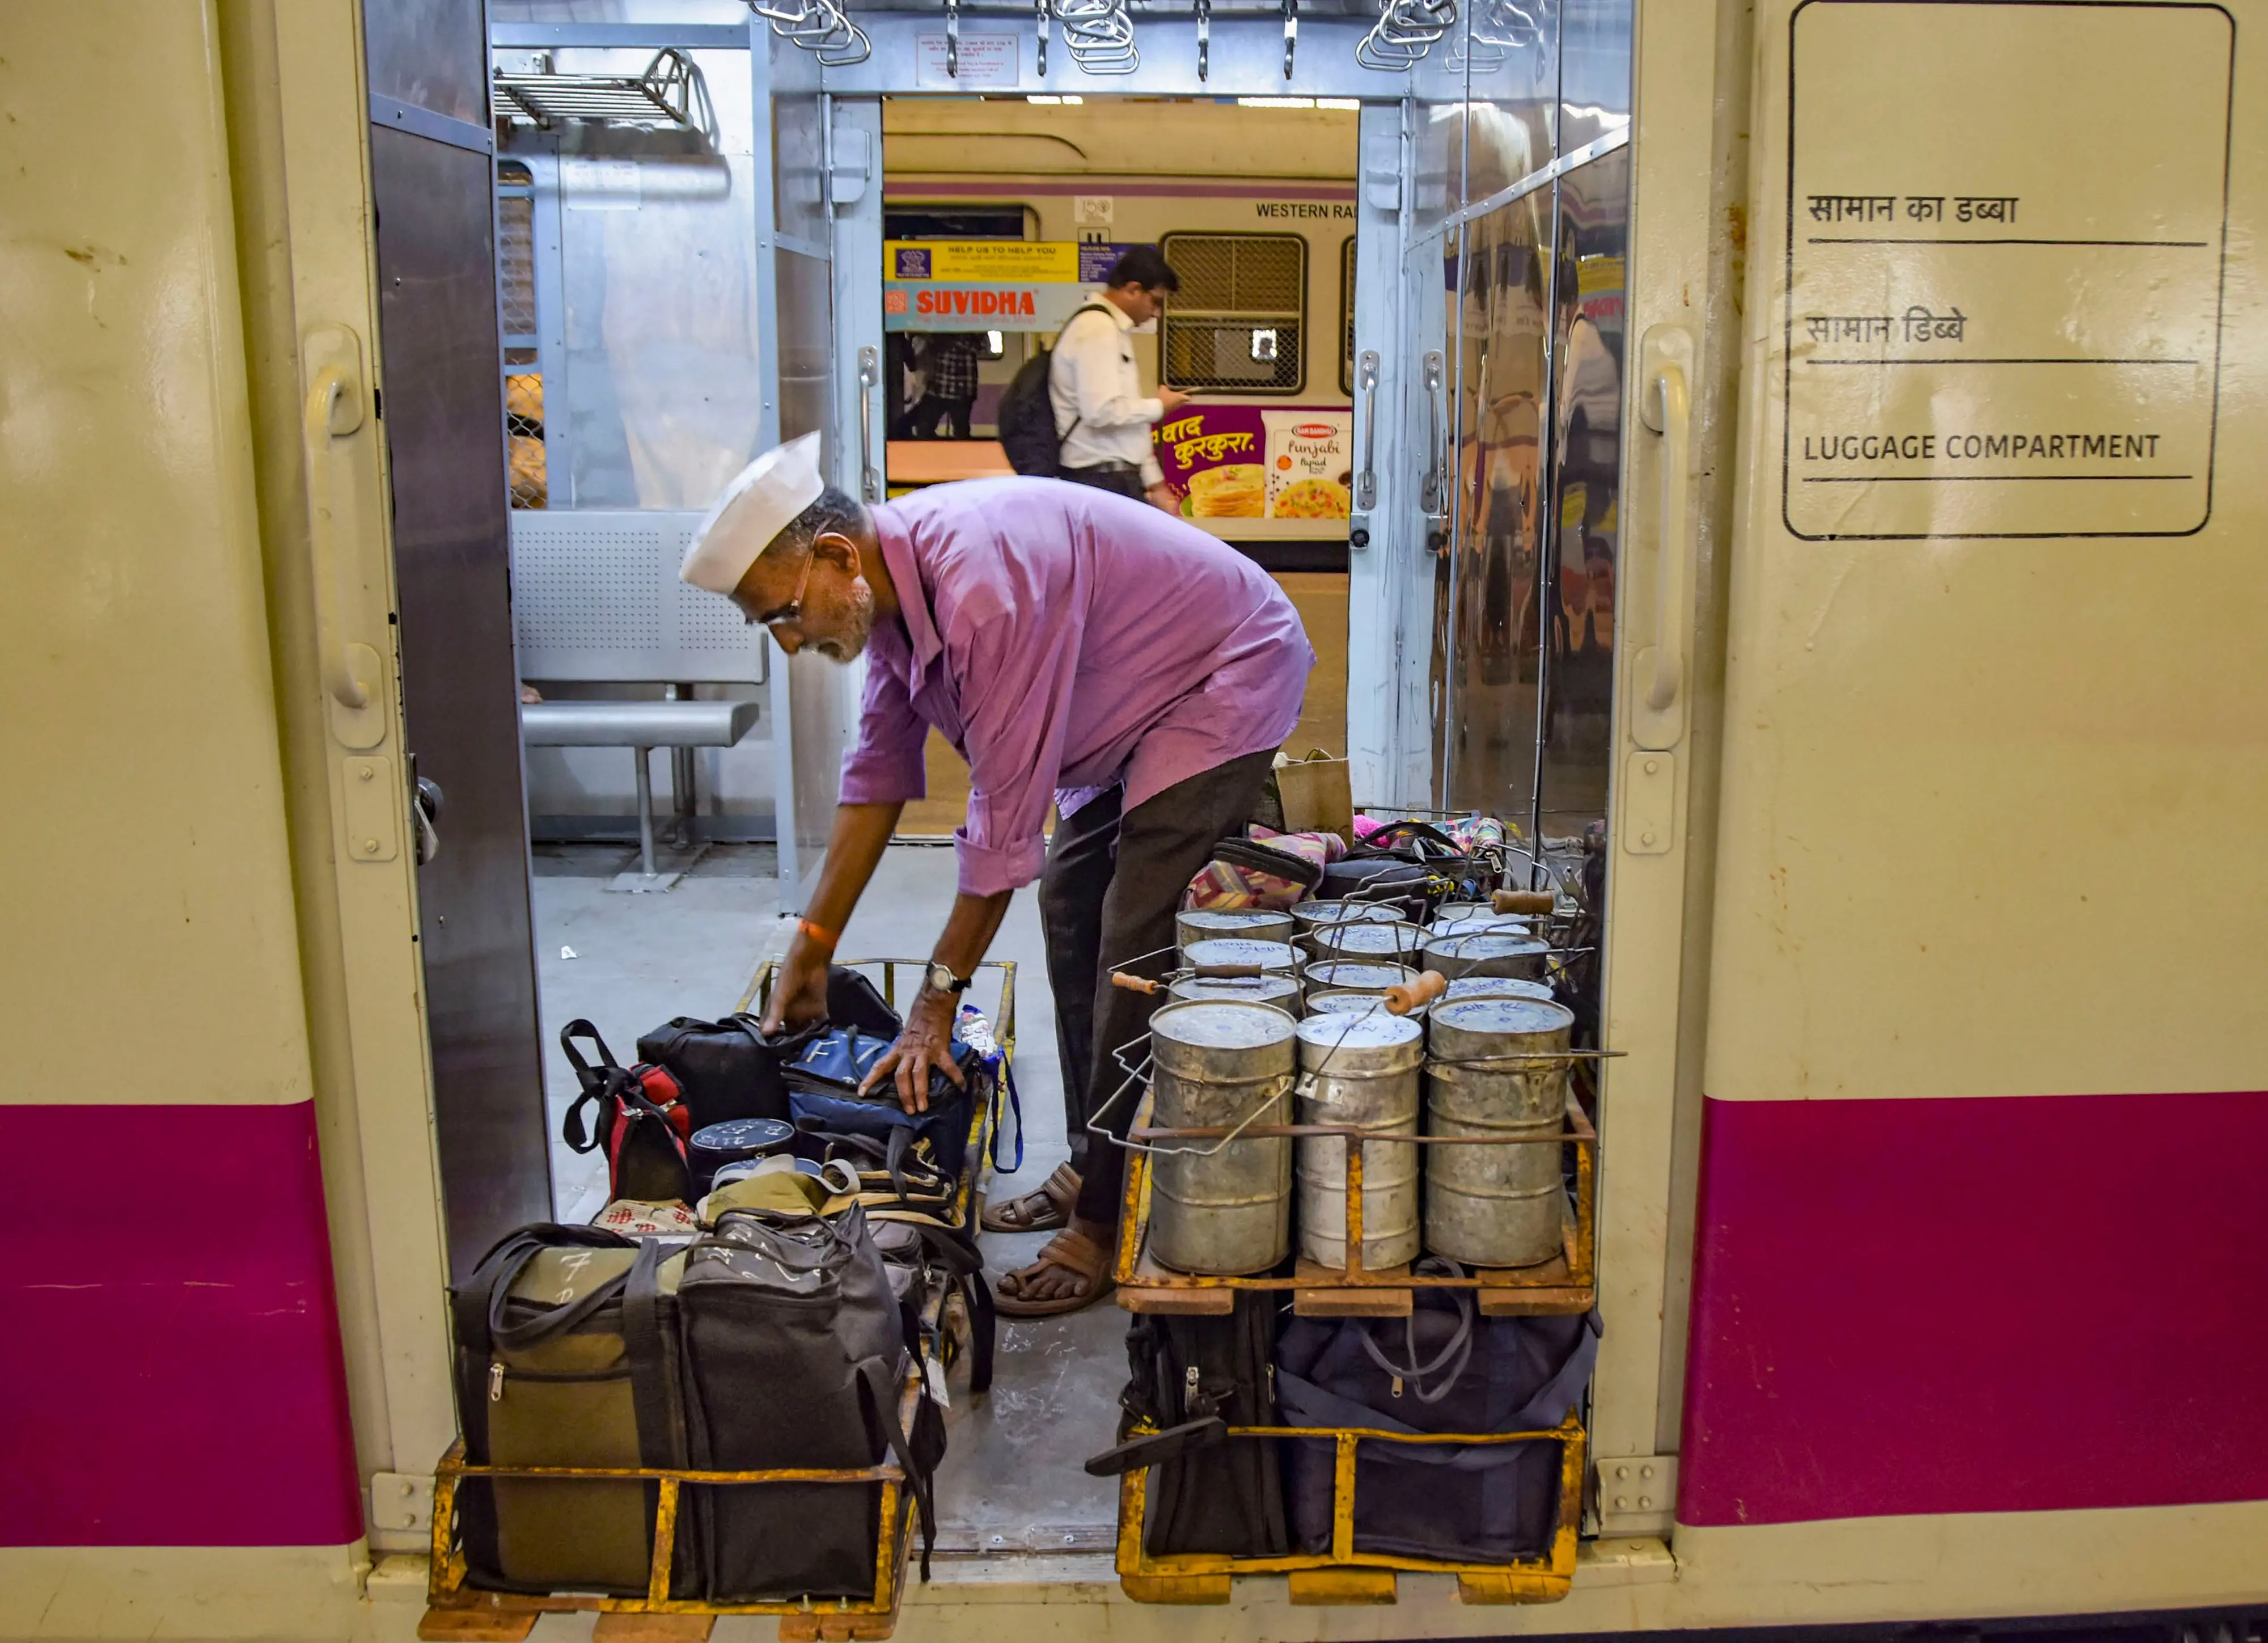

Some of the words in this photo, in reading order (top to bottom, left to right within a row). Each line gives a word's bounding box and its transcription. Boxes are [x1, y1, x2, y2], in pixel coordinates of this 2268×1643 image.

[1256, 203, 1328, 218] WESTERN
[1807, 196, 1897, 222] सामान
[1906, 197, 1945, 222] का
[1953, 197, 2020, 223] डब्बा
[916, 289, 1035, 315] SUVIDHA
[1805, 316, 1894, 343] सामान
[1902, 305, 1967, 343] डिब्बे
[1288, 440, 1340, 458] Punjabi
[1805, 435, 1936, 460] LUGGAGE
[1946, 434, 2160, 459] COMPARTMENT
[1300, 457, 1326, 473] Papad
